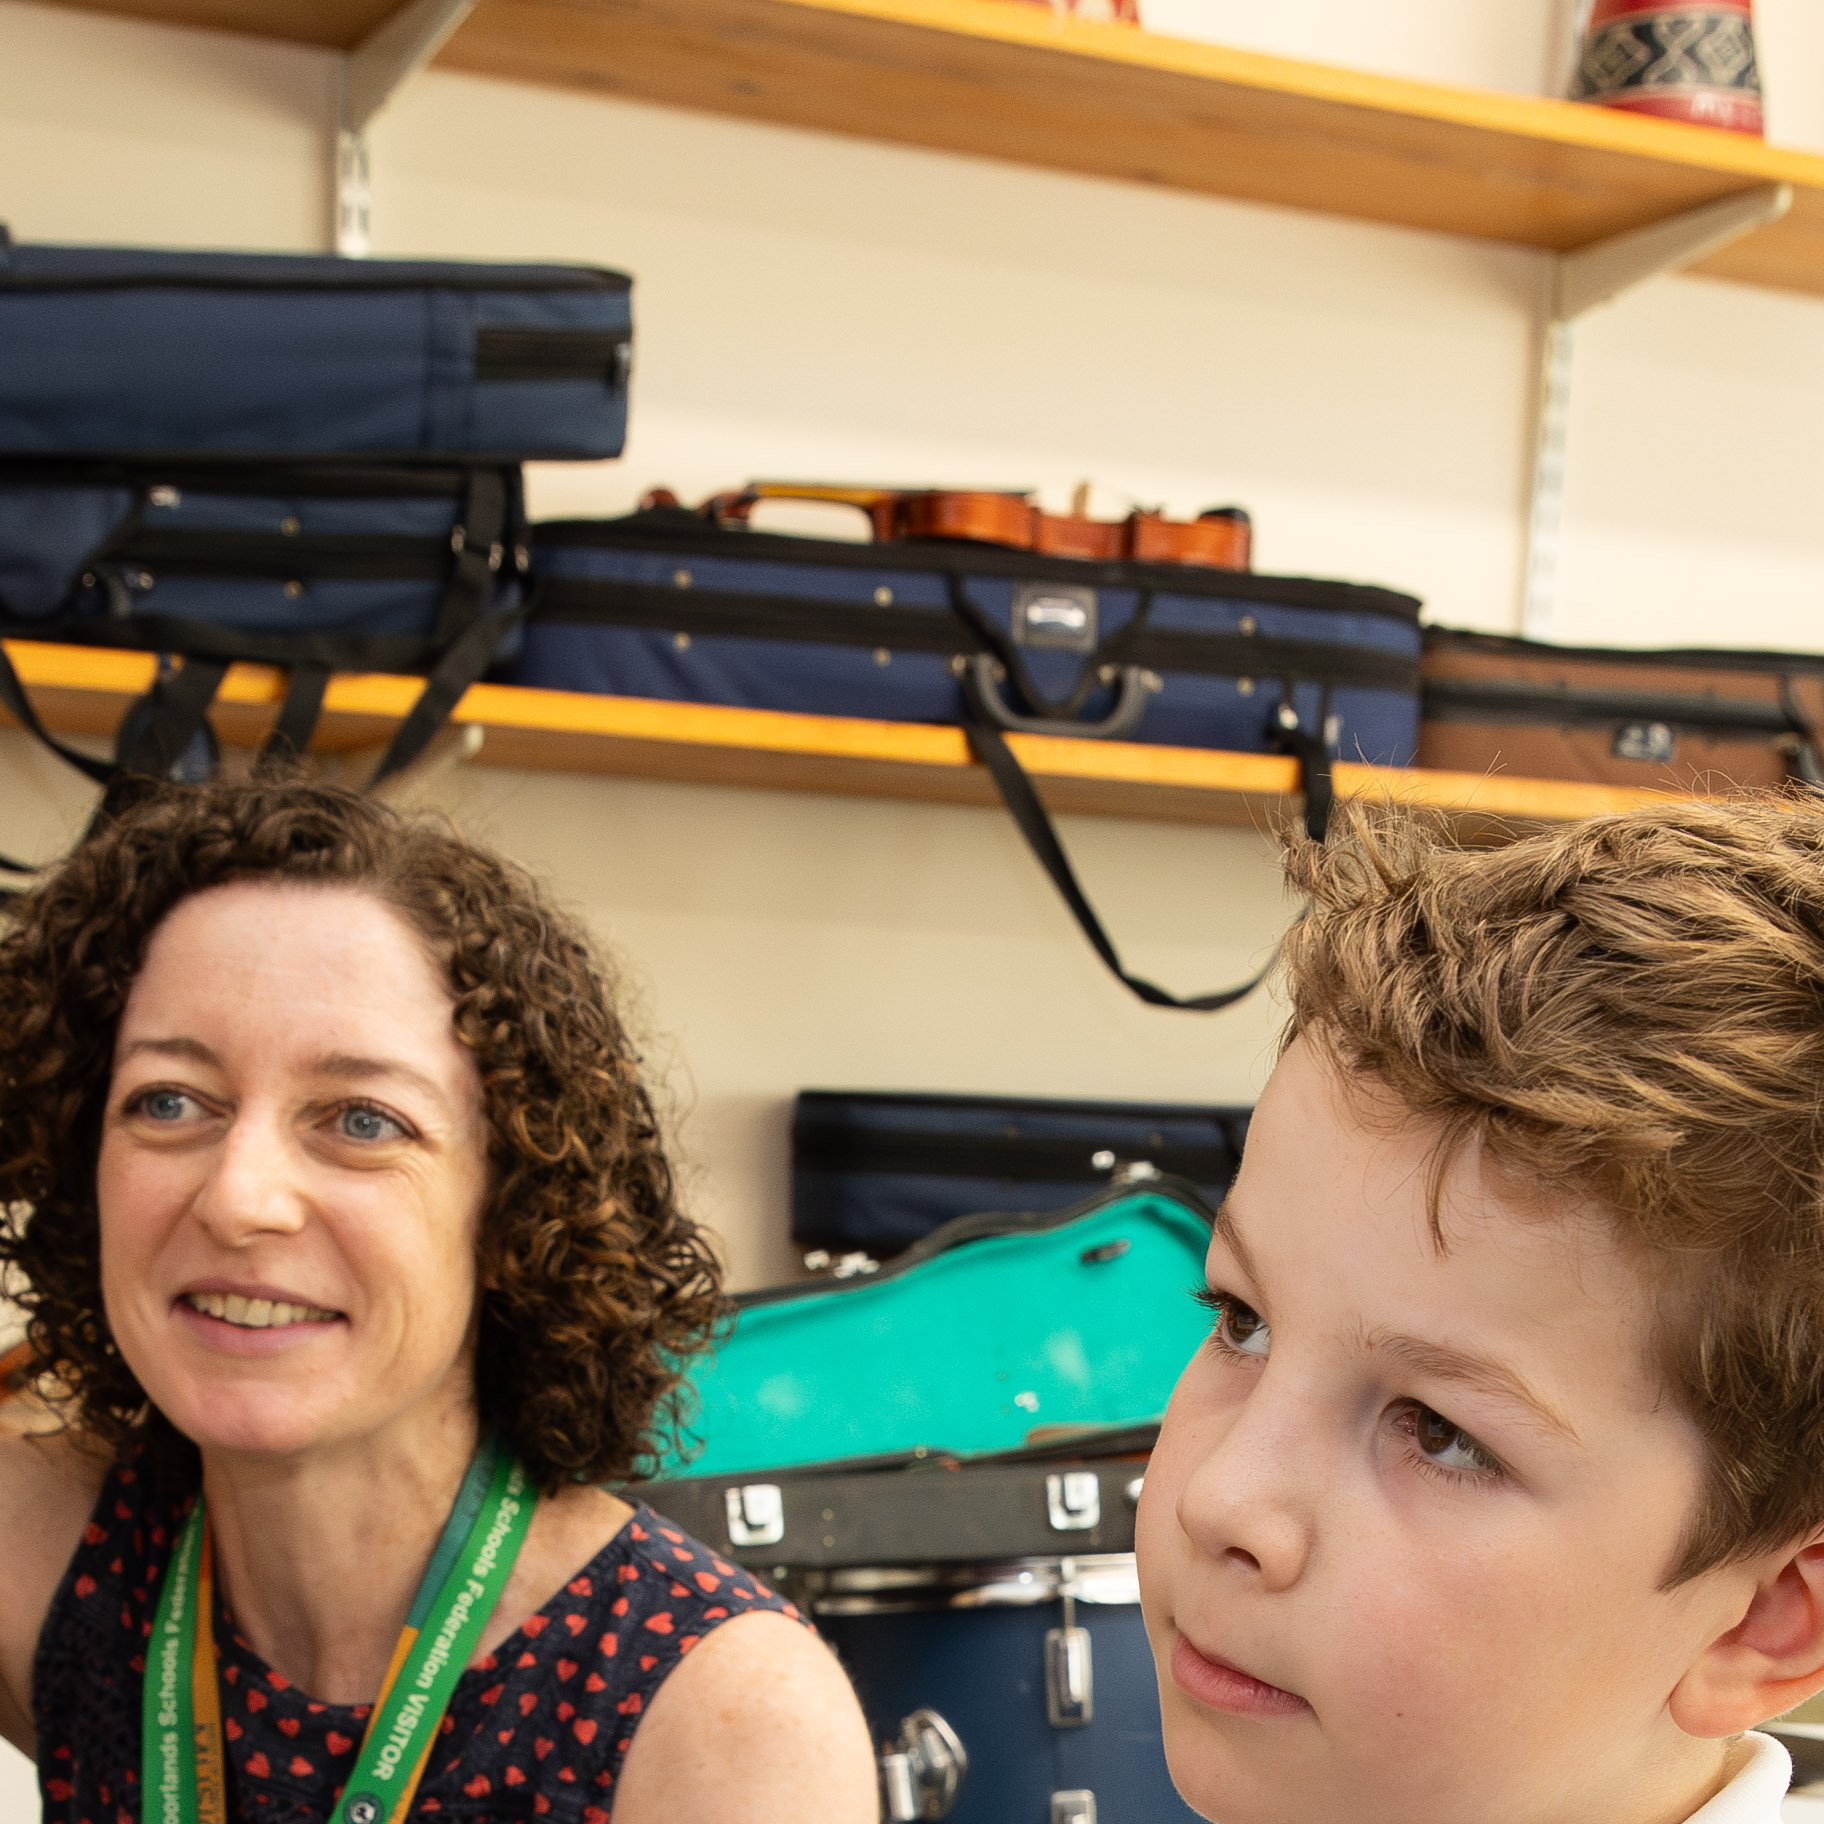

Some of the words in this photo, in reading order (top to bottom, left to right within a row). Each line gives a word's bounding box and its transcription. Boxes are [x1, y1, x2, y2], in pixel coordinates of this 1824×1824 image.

[472, 1497, 521, 1578] Schools
[415, 1578, 485, 1690] Federation
[158, 1637, 180, 1728] Schools
[371, 1693, 430, 1782] VISITOR
